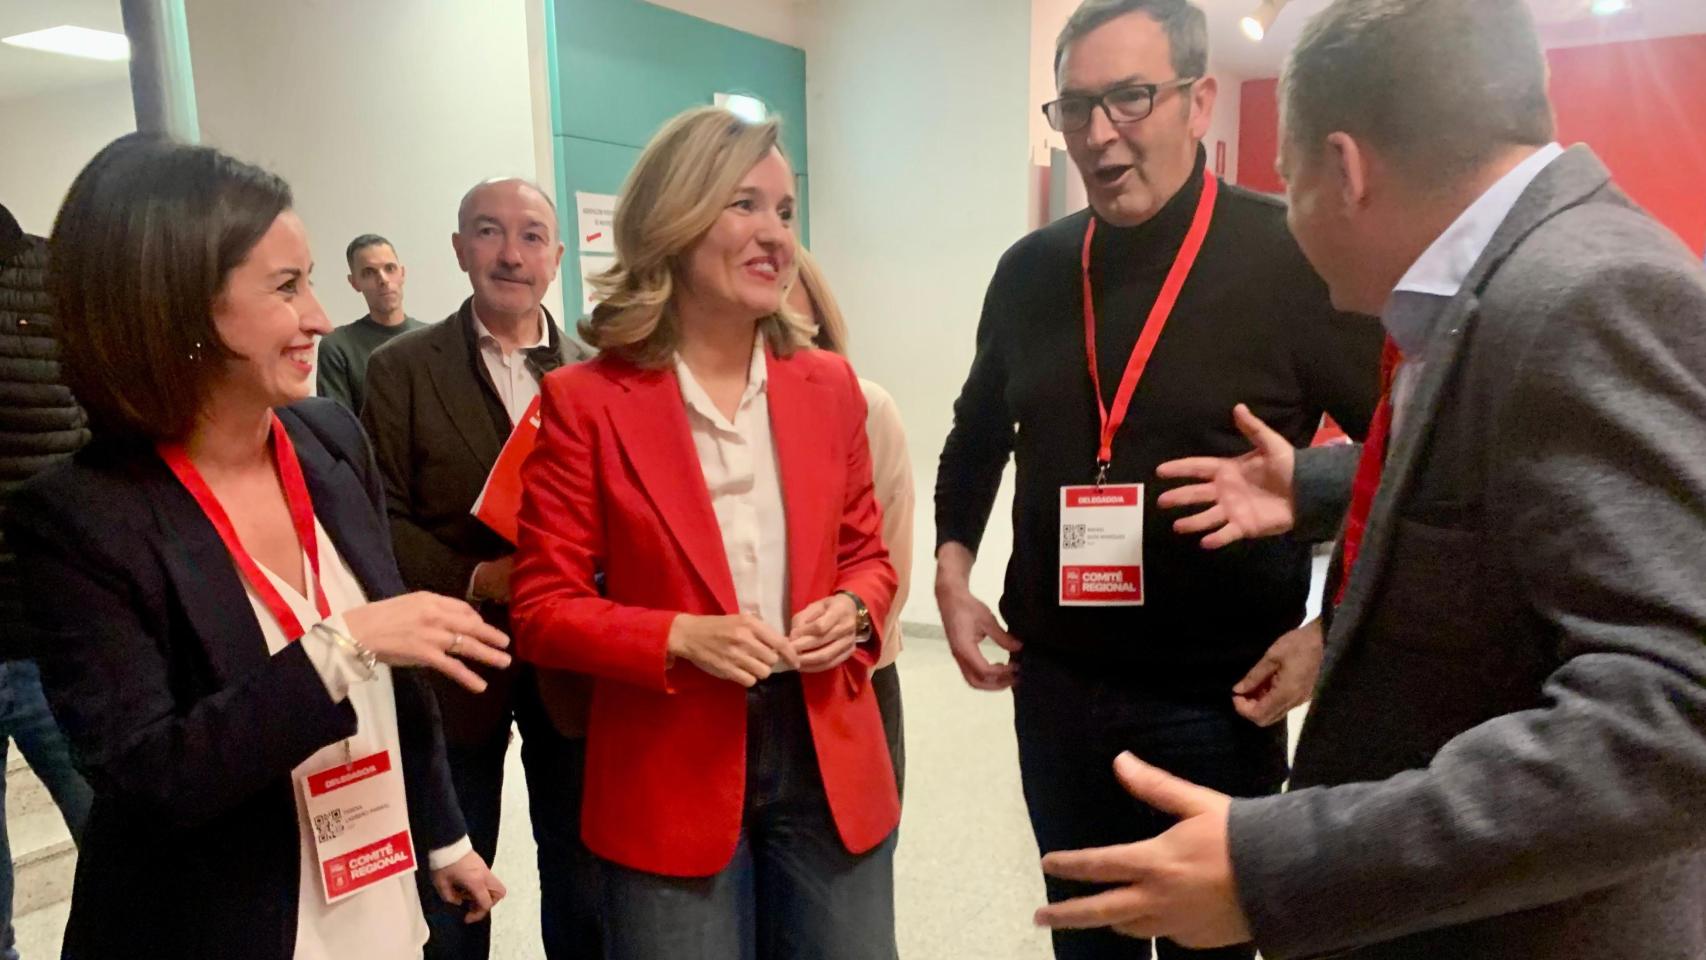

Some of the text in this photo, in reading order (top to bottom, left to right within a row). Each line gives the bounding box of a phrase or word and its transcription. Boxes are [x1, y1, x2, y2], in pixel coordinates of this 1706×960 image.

[1082, 570, 1123, 582] COMITÉ
[1082, 582, 1136, 593] REGIONAL
[348, 842, 394, 870] COMITÉ
[350, 850, 409, 880] REGIONAL
